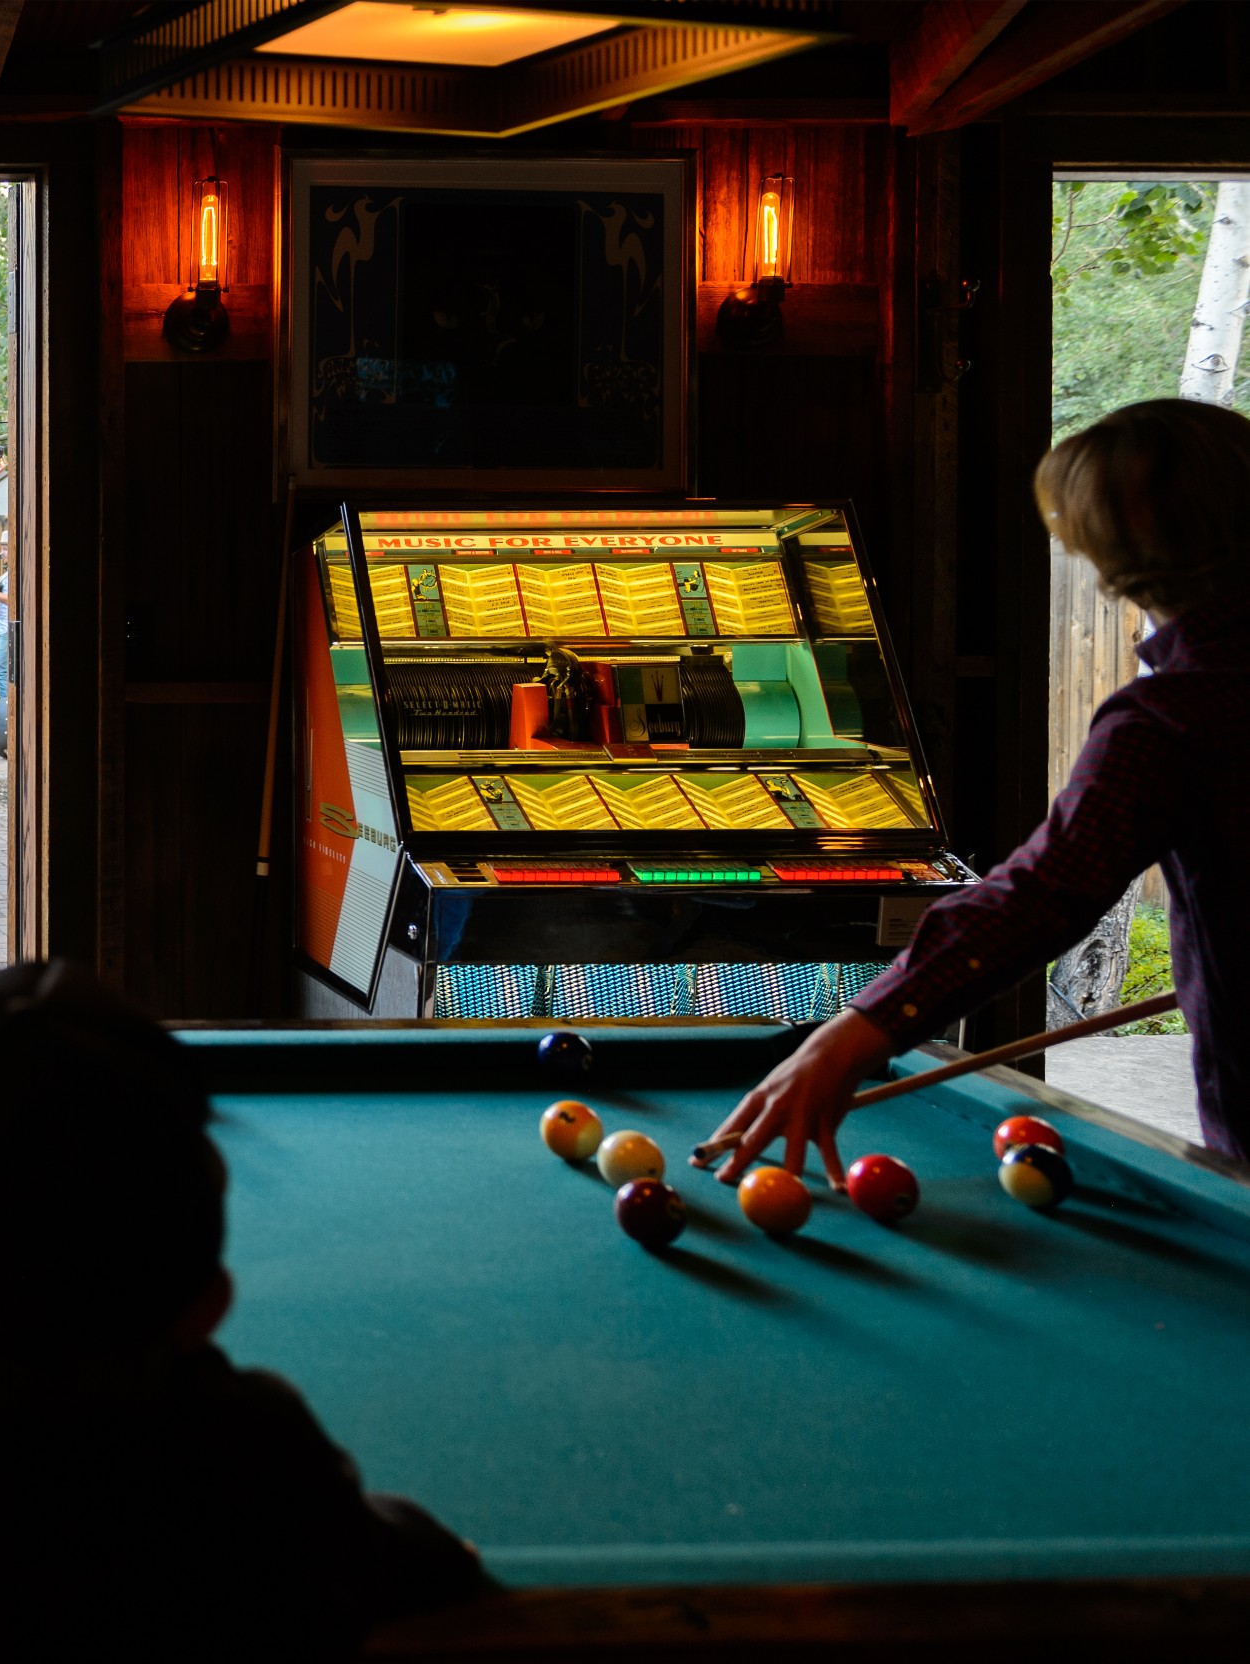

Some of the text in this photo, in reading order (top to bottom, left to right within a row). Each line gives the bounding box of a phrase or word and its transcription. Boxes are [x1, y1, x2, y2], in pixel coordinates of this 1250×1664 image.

[378, 535, 724, 549] MUSIC FOR EVERYONE
